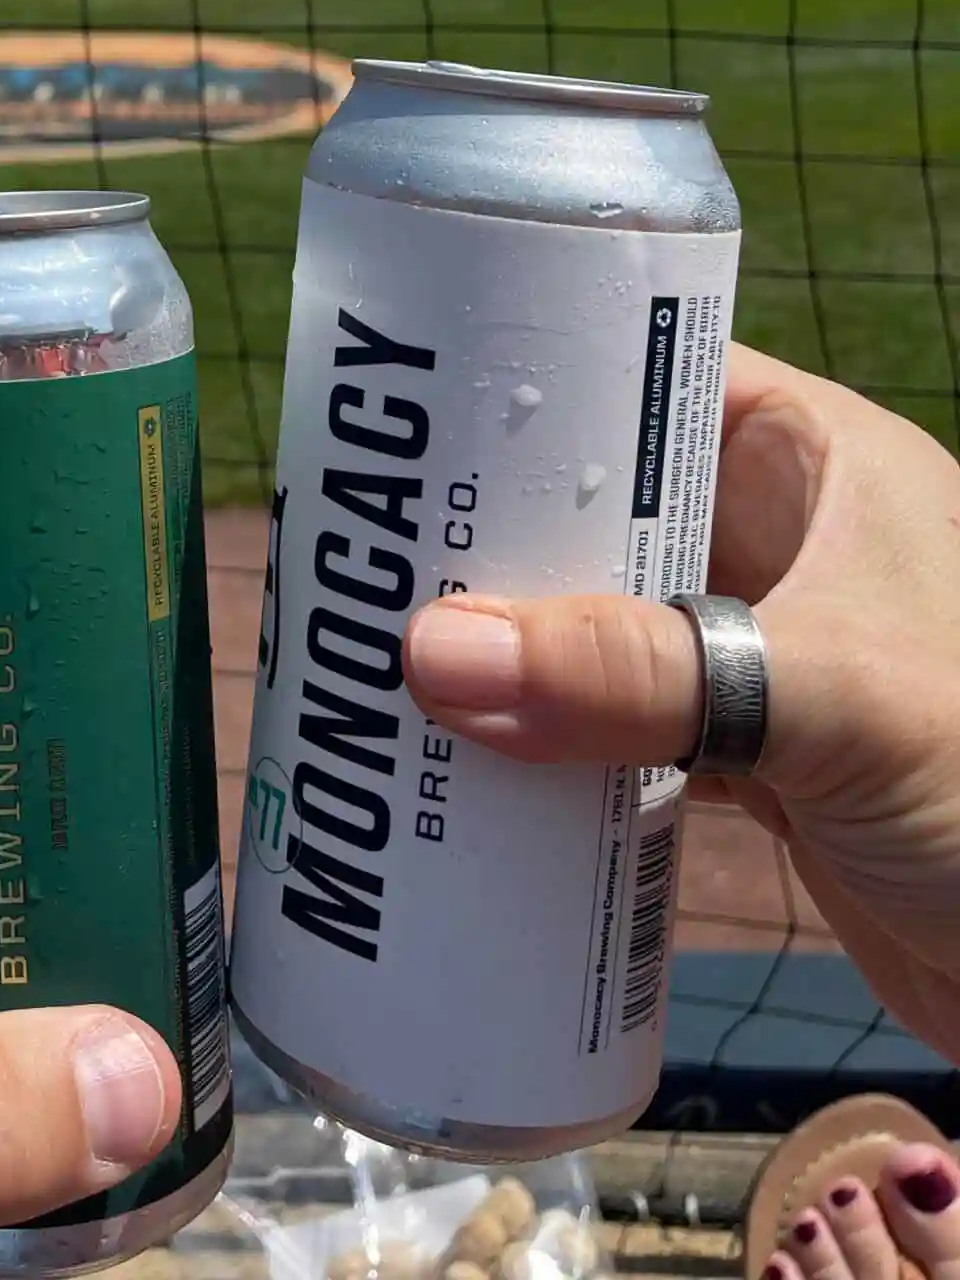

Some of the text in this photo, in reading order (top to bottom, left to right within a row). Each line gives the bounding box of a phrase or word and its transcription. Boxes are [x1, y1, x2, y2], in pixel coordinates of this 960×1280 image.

[684, 297, 698, 342] SHOULD
[679, 345, 693, 389] WOMEN
[641, 335, 667, 505] RECYCLABLE ALUMINUM
[675, 296, 711, 590] DURING PREGNANCY BECAUSE OF THE RISK OF BIRTH
[669, 447, 683, 501] SURGEON
[147, 444, 165, 606] RECYCLABLE ALUMINUM
[662, 527, 676, 541] TO
[666, 505, 679, 524] THE
[633, 530, 649, 596] MD 21701
[660, 543, 675, 603] CCORDING
[280, 307, 438, 961] MONOCACY
[415, 472, 479, 843] BREG CO.
[602, 840, 621, 910] Company
[595, 912, 613, 975] Brewing
[587, 977, 606, 1054] Monocacy
